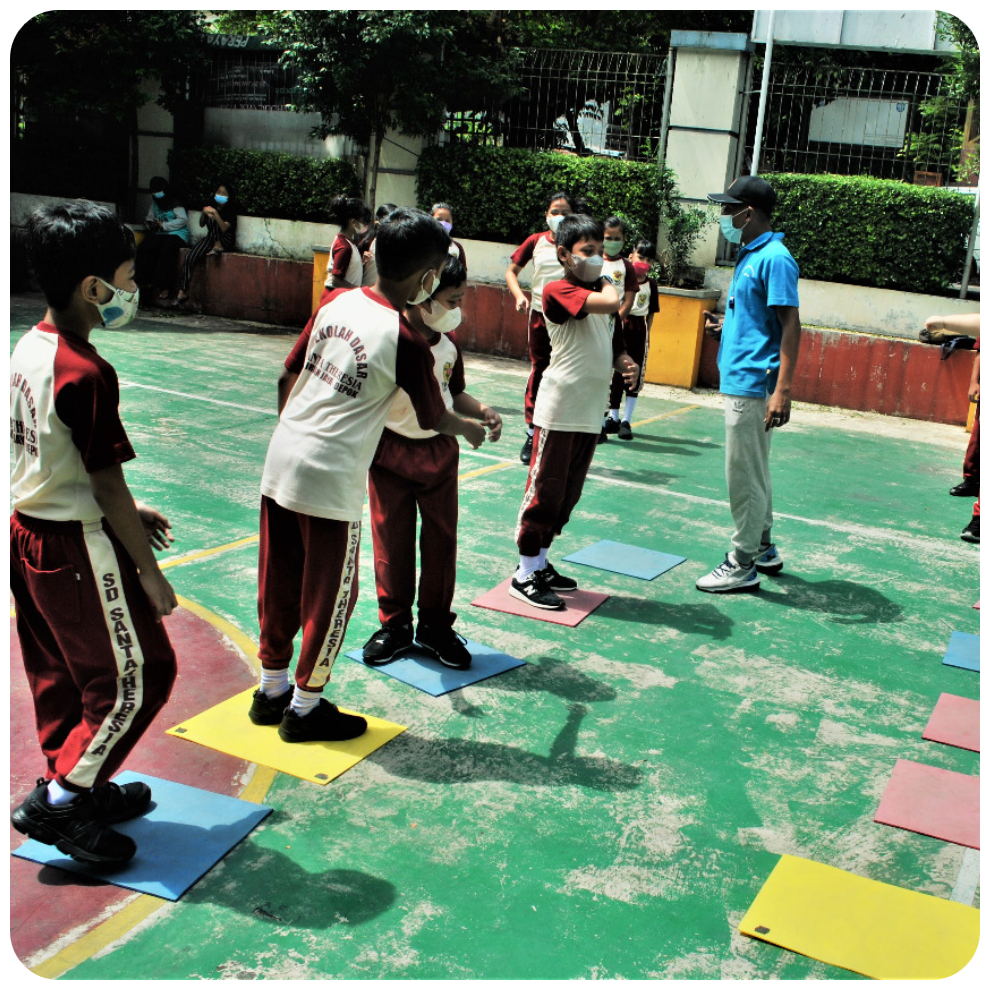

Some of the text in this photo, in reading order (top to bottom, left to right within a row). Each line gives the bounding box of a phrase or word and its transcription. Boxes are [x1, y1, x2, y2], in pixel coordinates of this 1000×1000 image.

[349, 336, 368, 379] DASAR
[333, 382, 360, 399] DEPOK
[102, 573, 119, 602] SD
[109, 607, 138, 673] SANTA
[319, 590, 350, 667] THERESIA
